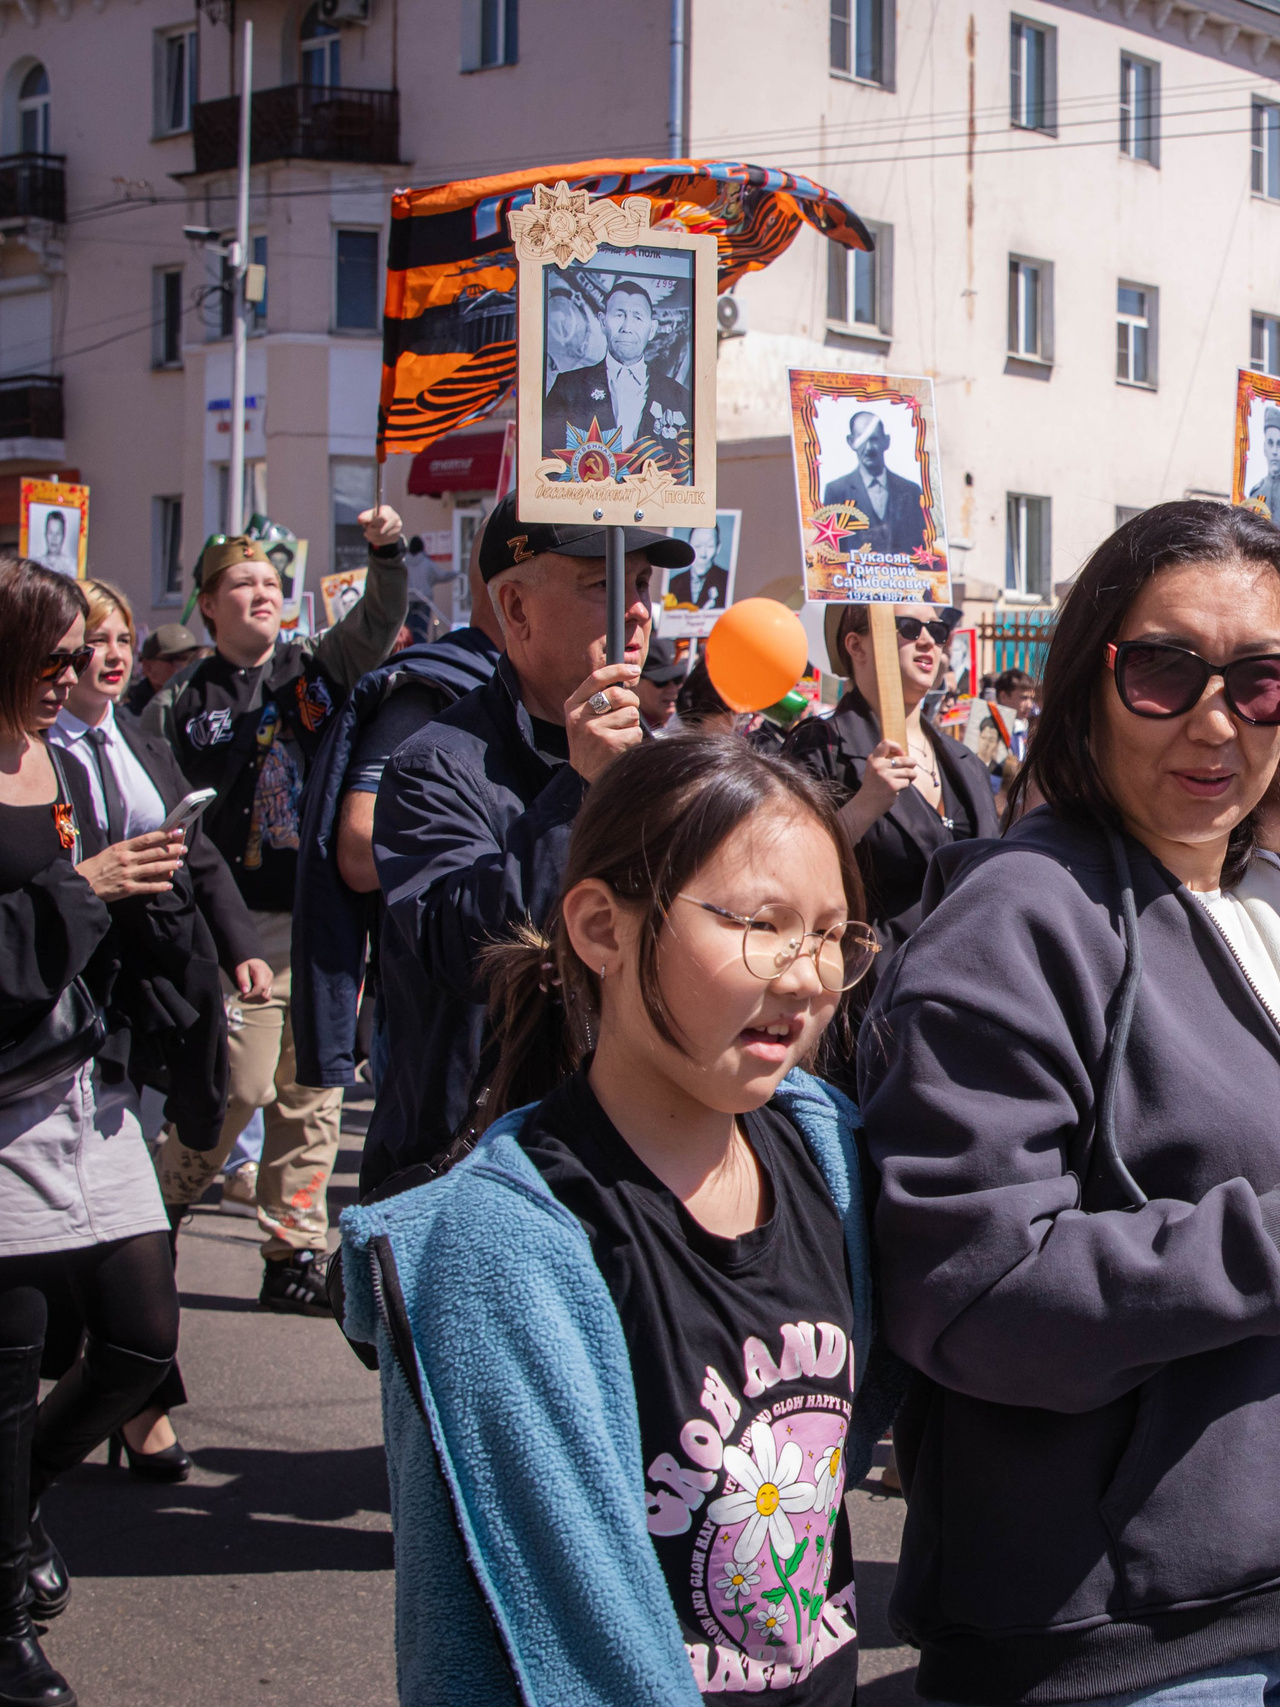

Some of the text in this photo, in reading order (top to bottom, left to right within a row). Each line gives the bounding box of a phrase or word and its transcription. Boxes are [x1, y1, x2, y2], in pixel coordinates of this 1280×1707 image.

[664, 490, 706, 505] ПОЛК
[850, 549, 911, 565] Гукасян
[846, 562, 916, 578] Григорий
[833, 574, 931, 591] Сарибекович
[847, 591, 904, 601] 1921-1987
[743, 1321, 848, 1398] AND
[771, 1395, 805, 1417] GLOW
[805, 1394, 842, 1411] HAPPY
